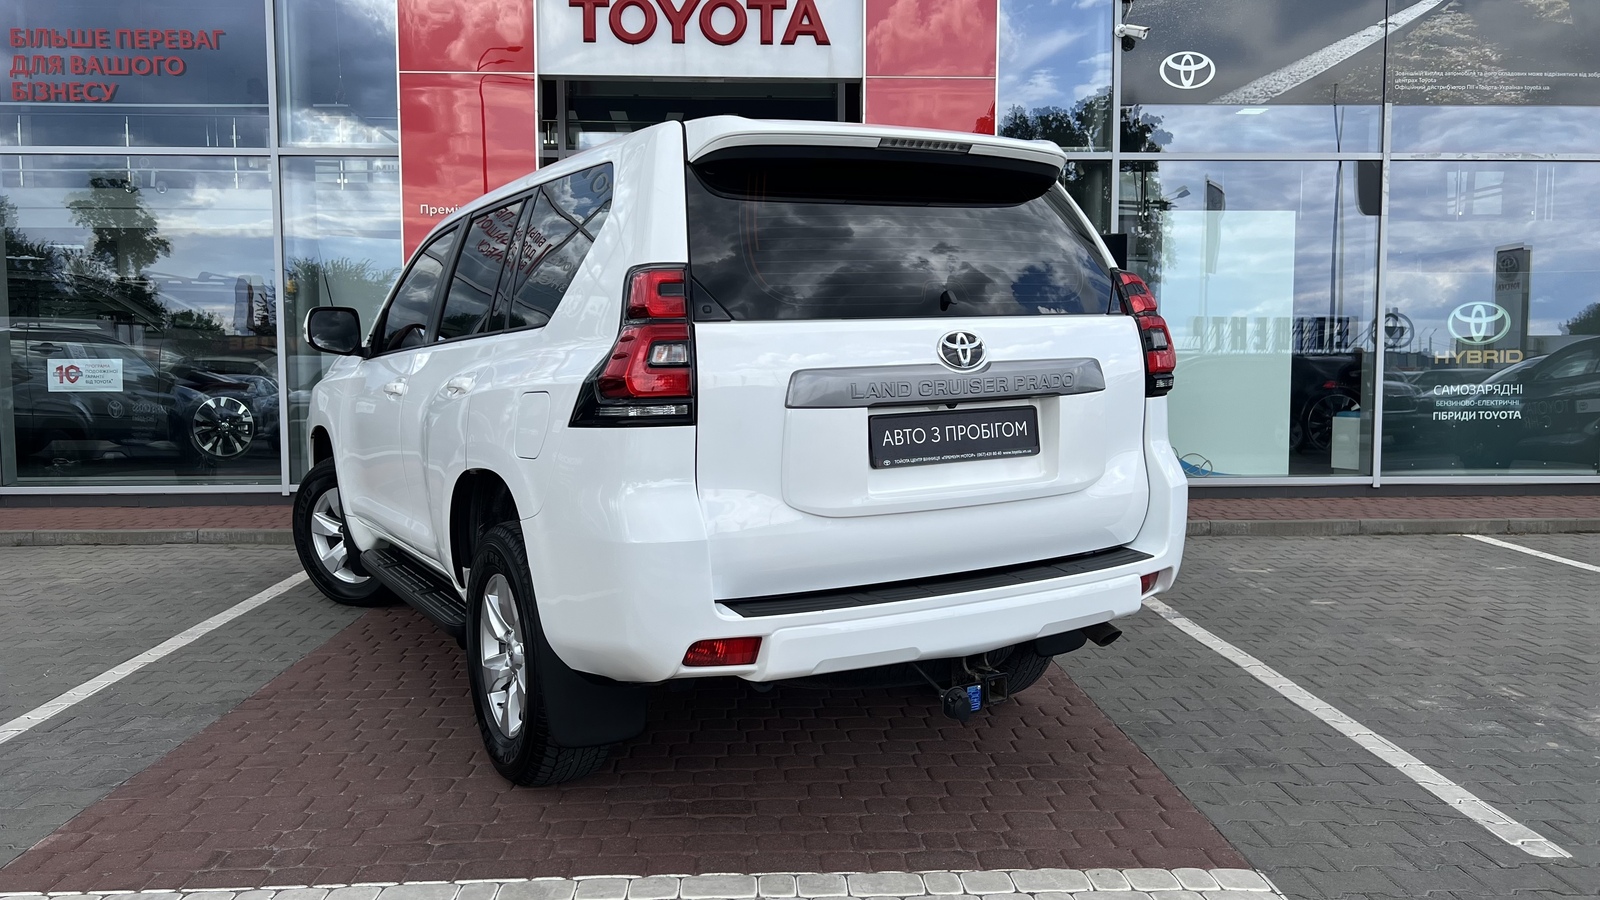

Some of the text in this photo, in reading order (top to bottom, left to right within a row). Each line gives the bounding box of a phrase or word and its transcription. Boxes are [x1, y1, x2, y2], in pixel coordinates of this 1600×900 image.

[569, 0, 831, 45] TOYOTA
[9, 28, 225, 49] БІЛЬШЕ ПЕРЕВАГ
[9, 55, 185, 78] ДЛЯ ВАШОГО
[11, 81, 117, 101] БІЗНЕСУ
[420, 203, 461, 217] Премі
[1434, 349, 1524, 365] HYBRID
[850, 371, 1076, 400] LAND CRUISER PRADO
[1433, 384, 1523, 397] САМОЗАРЯДНІ
[1435, 399, 1520, 408] БЕНЗИНОВО-ЕЛЕКТРИЧНІ
[1432, 410, 1522, 422] ГІБРИДИ TOYOTA
[882, 427, 926, 447] АВТО
[945, 420, 1028, 442] ПРОБІГОМ
